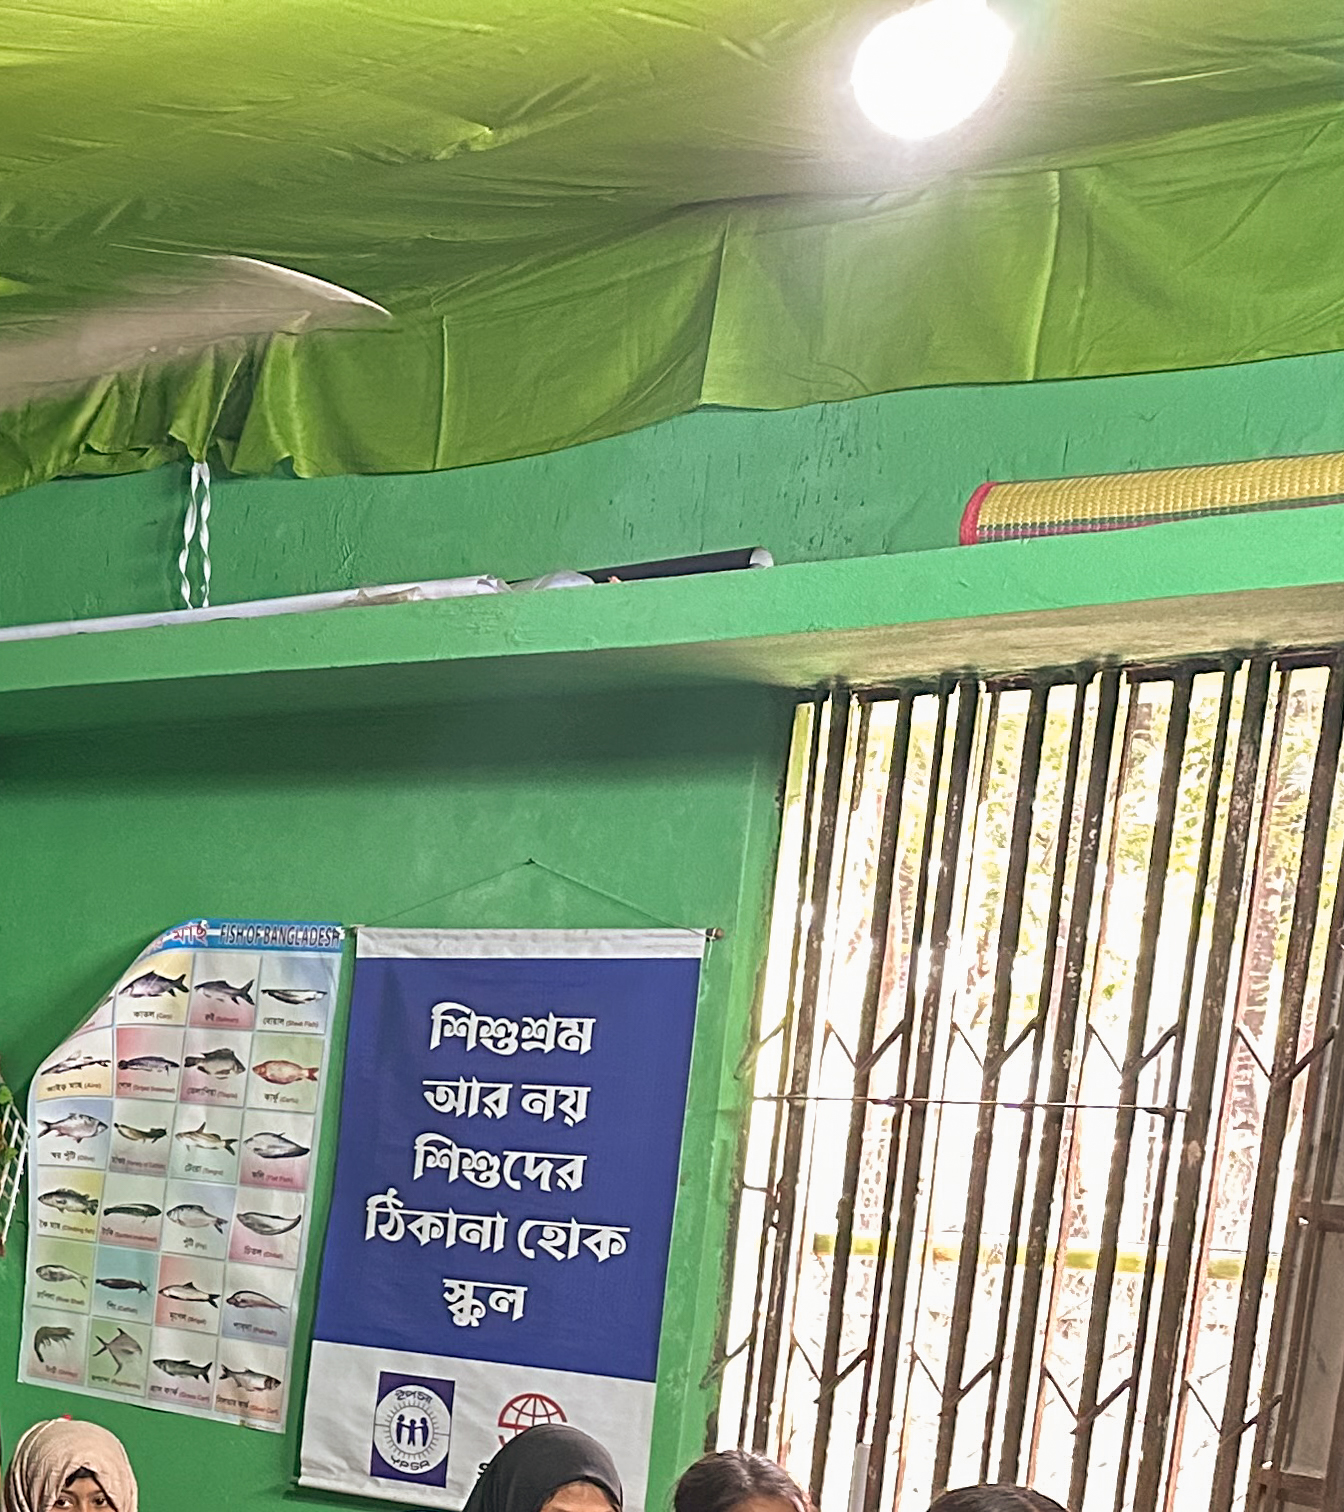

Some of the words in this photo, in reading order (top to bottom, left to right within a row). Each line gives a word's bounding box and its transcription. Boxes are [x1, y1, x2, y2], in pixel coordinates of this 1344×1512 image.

[220, 924, 243, 944] FISH
[247, 926, 261, 944] OF
[428, 1001, 597, 1056] শিশুশ্রম
[422, 1075, 514, 1122] আর
[520, 1083, 592, 1128] নয়
[413, 1132, 588, 1192] শিশুদের
[364, 1186, 508, 1256] ঠিকানা
[516, 1220, 631, 1263] হোক
[442, 1278, 529, 1328] স্কুল
[390, 1455, 431, 1471] YPSA
